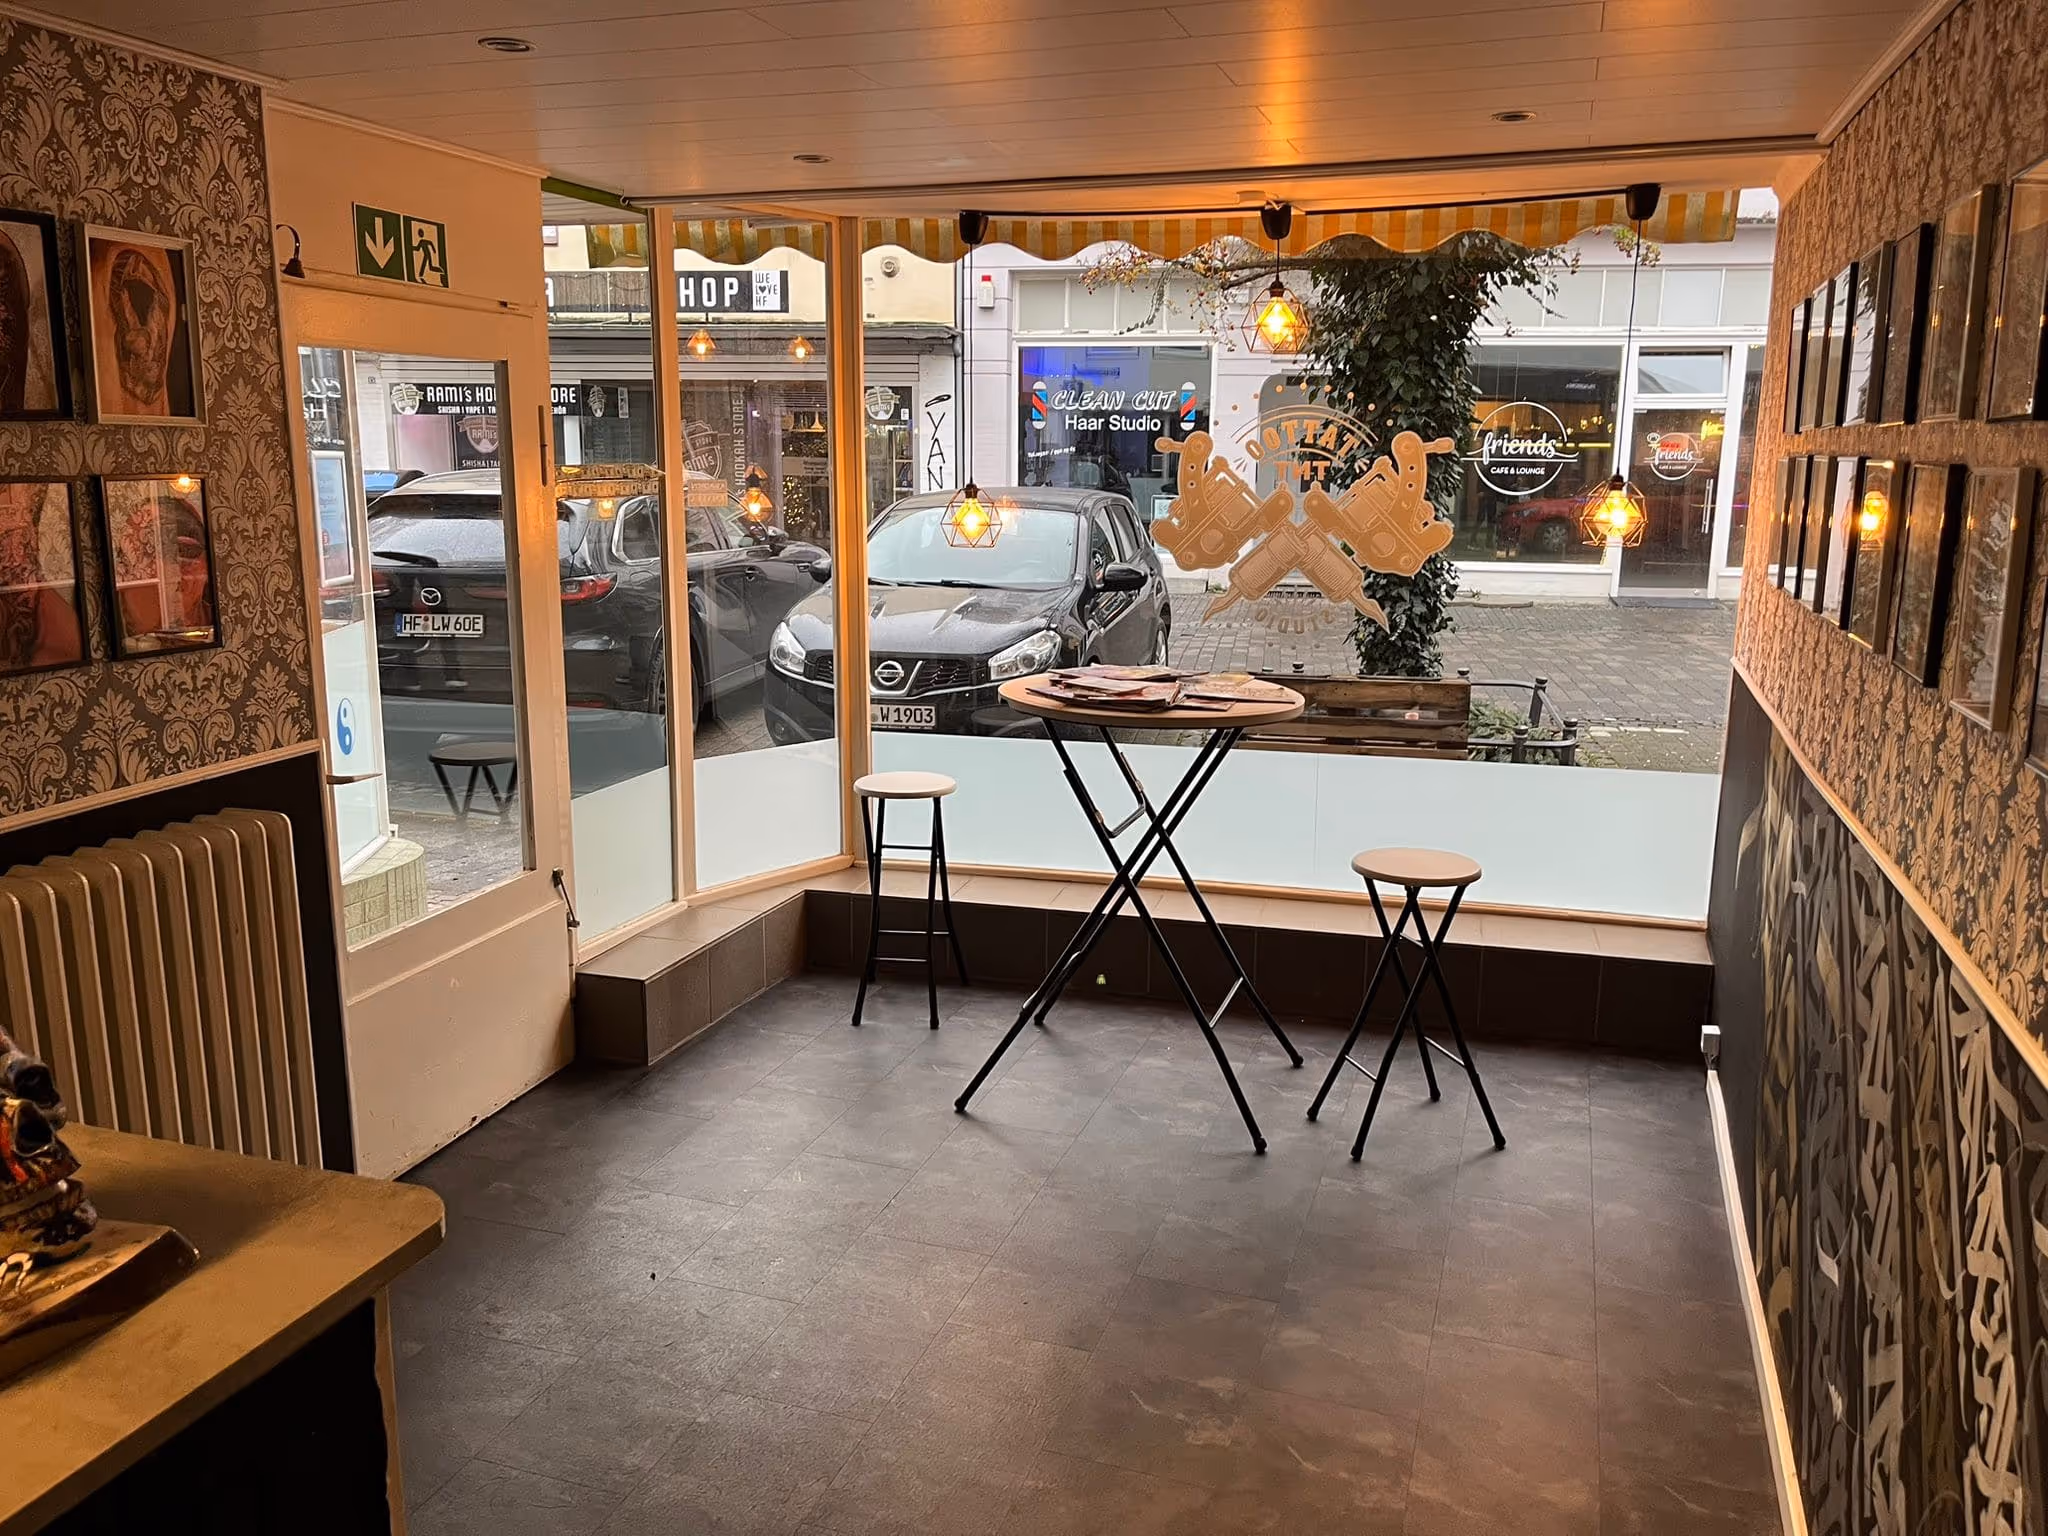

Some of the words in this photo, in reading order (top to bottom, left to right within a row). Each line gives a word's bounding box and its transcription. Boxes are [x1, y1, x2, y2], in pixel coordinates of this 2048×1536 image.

[755, 272, 771, 284] WE
[679, 277, 739, 307] HOP
[755, 295, 768, 307] HF
[550, 387, 577, 404] ORE
[1051, 389, 1125, 411] CLEAN
[1131, 390, 1177, 411] CUT
[732, 399, 745, 436] STORE
[1065, 414, 1105, 431] Haar
[1108, 414, 1161, 431] Studio
[1481, 432, 1557, 465] friends
[1654, 447, 1694, 466] friends
[733, 440, 746, 486] HOOKAH
[1490, 466, 1509, 475] CAFE
[1516, 466, 1546, 475] LOUNGE
[403, 615, 422, 631] HF
[431, 615, 451, 632] LW
[454, 616, 482, 632] 60E
[893, 707, 933, 723] 1903
